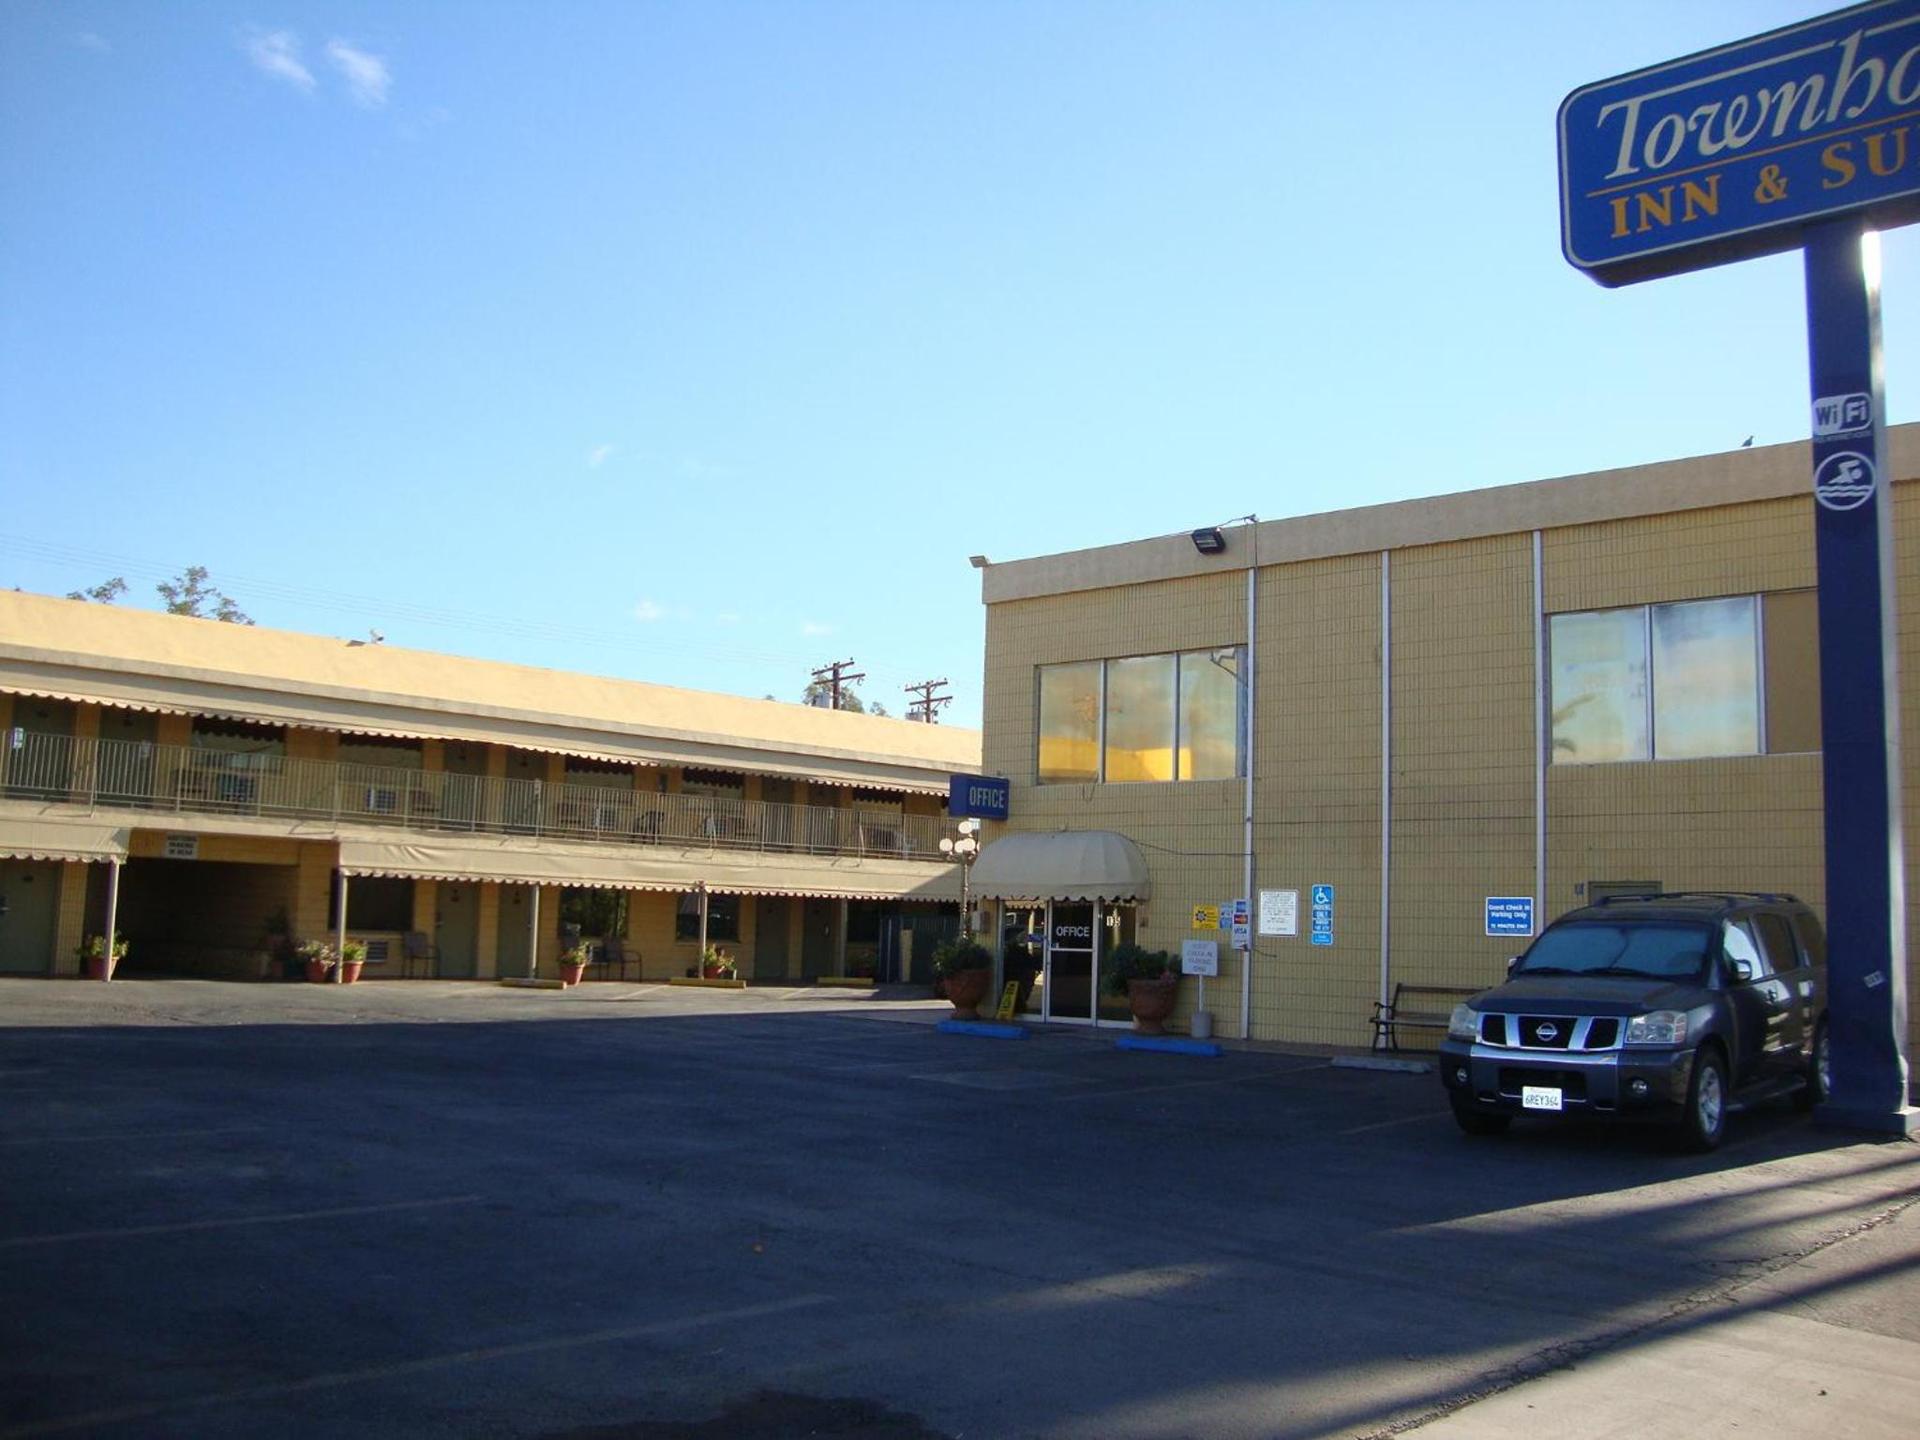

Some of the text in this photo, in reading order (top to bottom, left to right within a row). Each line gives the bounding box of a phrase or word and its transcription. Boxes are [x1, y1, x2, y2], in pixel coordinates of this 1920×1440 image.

[1609, 175, 1721, 239] INN
[1754, 164, 1789, 204] &
[970, 785, 1005, 809] OFFICE
[1513, 911, 1527, 919] Only
[1055, 926, 1090, 937] OFFICE
